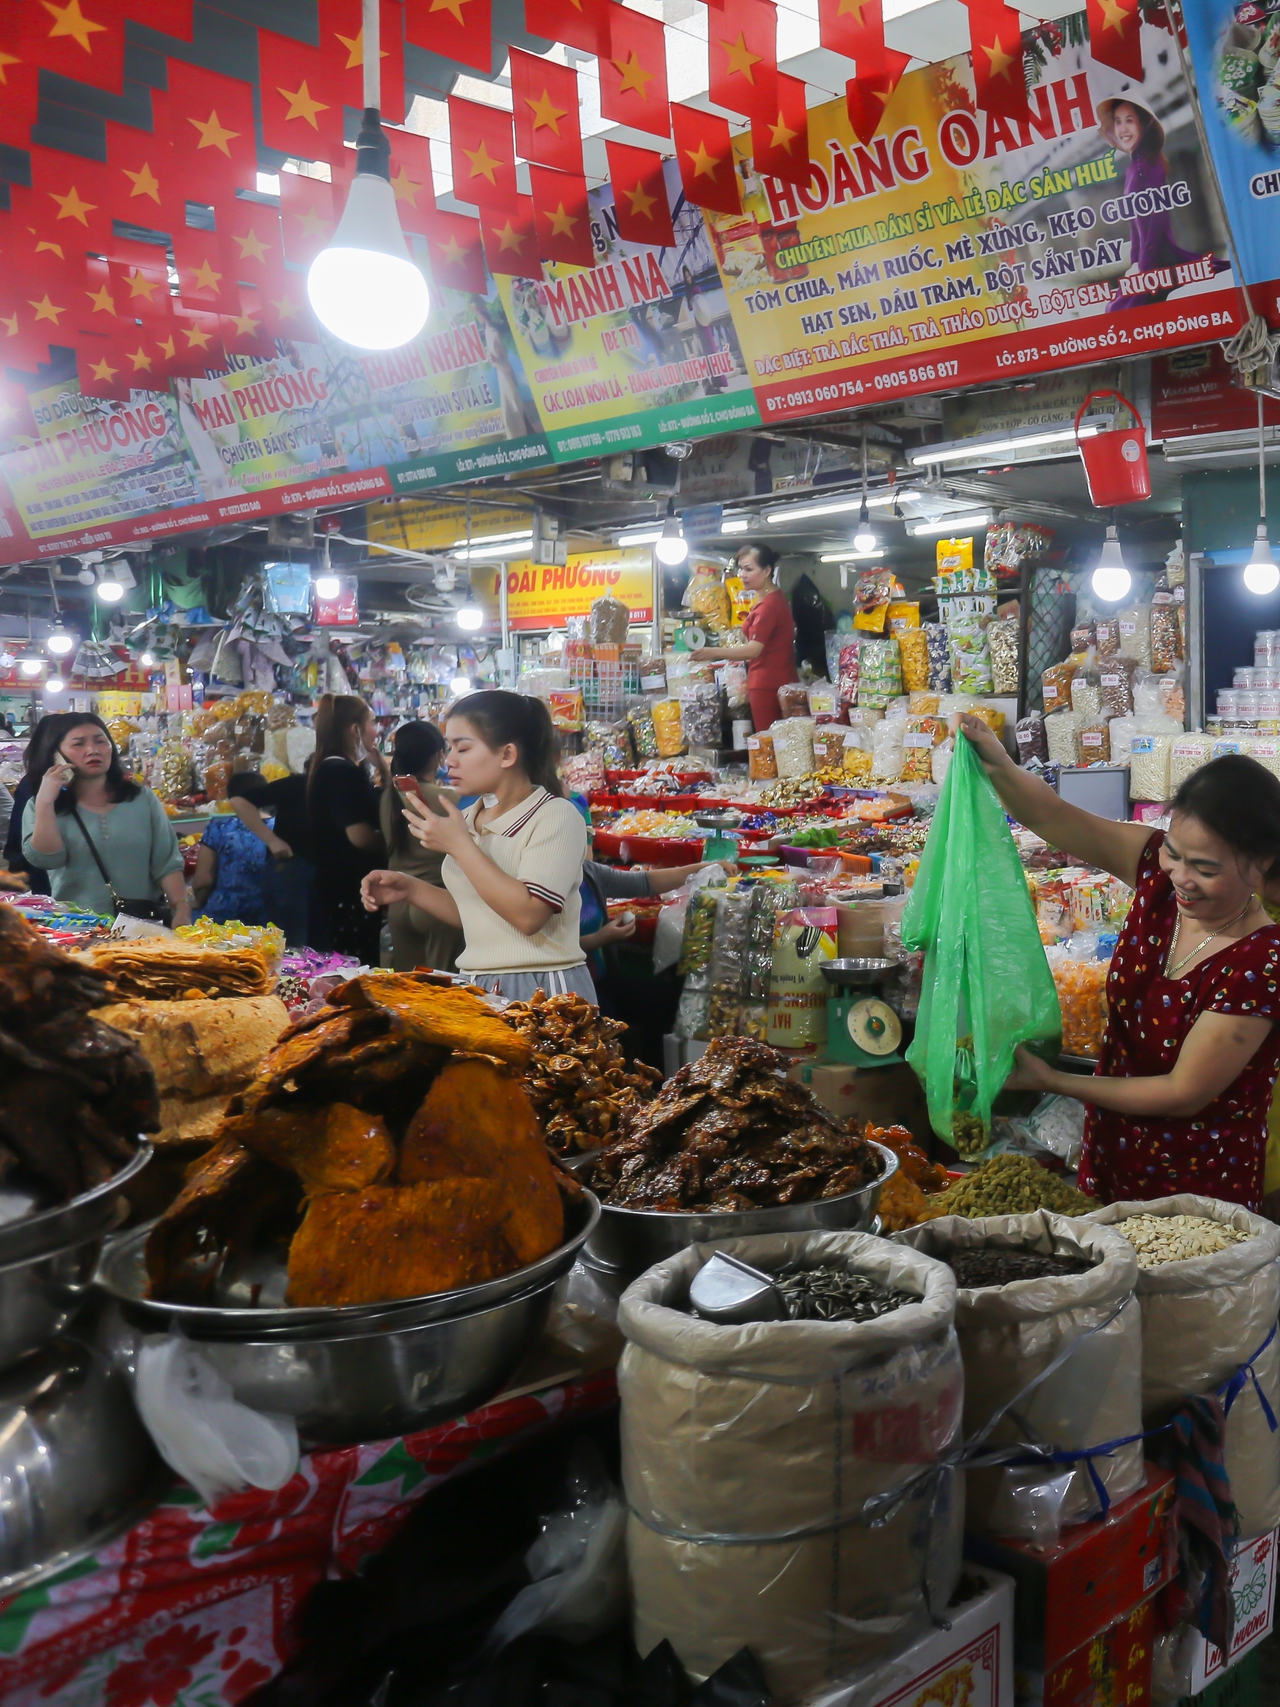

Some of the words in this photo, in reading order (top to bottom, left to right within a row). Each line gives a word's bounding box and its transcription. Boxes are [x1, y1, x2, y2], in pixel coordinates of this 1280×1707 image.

[762, 128, 930, 223] HOÀNG
[940, 72, 1098, 166] OANH
[745, 287, 781, 314] TÔM
[784, 276, 835, 304] CHUA,
[836, 261, 881, 292] MẮM
[883, 245, 943, 280] RUỐC,
[945, 236, 975, 263] MÈ
[979, 219, 1045, 256] XỬNG,
[1049, 206, 1096, 240] KẸO
[1101, 182, 1191, 224] GƯƠNG
[775, 233, 835, 269] CHUYÊN
[836, 224, 875, 253] MUA
[876, 213, 914, 242] BÁN
[915, 202, 935, 230] SỈ
[934, 196, 962, 223] VÀ
[963, 187, 985, 219] LẺ
[986, 177, 1027, 211] ĐẶC
[1030, 167, 1072, 200] SẢN
[1076, 149, 1118, 188] HUẾ
[543, 264, 625, 330] MẠNH
[621, 252, 672, 304] NA
[754, 354, 783, 377] ĐẶC
[783, 349, 813, 372] BIỆT:
[813, 340, 842, 363] TRÀ
[841, 332, 869, 355] BẮC
[869, 326, 909, 350] THÁI,
[910, 317, 941, 343] TRÀ
[941, 307, 984, 334] THẢO
[986, 298, 1039, 326] DƯỢC,
[1039, 290, 1075, 315] BỘT
[1077, 281, 1118, 306] SEN,
[1119, 270, 1172, 294] RƯỢU
[1174, 252, 1216, 283] HUẾ
[801, 311, 834, 336] HẠT
[838, 301, 877, 326] SEN,
[880, 288, 919, 316] DẦU
[921, 275, 983, 306] TRÀM,
[986, 262, 1026, 293] BỘT
[1031, 249, 1075, 280] SẮN
[1079, 238, 1124, 271] DÂY
[193, 393, 236, 432] MAI
[232, 367, 329, 421] PHƯỢNG
[359, 342, 428, 391] THANH
[423, 321, 487, 375] NHÀN
[543, 388, 564, 413] CÁC
[564, 385, 585, 409] LOẠI
[587, 378, 609, 402] NÓN
[609, 374, 624, 399] LÁ
[682, 355, 710, 385] NIỆM
[709, 343, 735, 376] HUẾ
[766, 395, 787, 412] ĐT:
[787, 392, 814, 407] 0913
[815, 384, 839, 402] 060
[839, 379, 864, 397] 754
[874, 371, 908, 391] 0905
[910, 365, 936, 383] 866
[937, 360, 959, 377] 817
[996, 350, 1016, 367] LÔ:
[1017, 347, 1039, 362] 873
[1050, 336, 1097, 358] ĐƯỜNG
[1099, 324, 1118, 347] SỐ
[1119, 329, 1132, 345] 2,
[1133, 322, 1165, 340] CHỢ
[1166, 314, 1210, 335] ĐÔNG
[1211, 310, 1233, 326] BA
